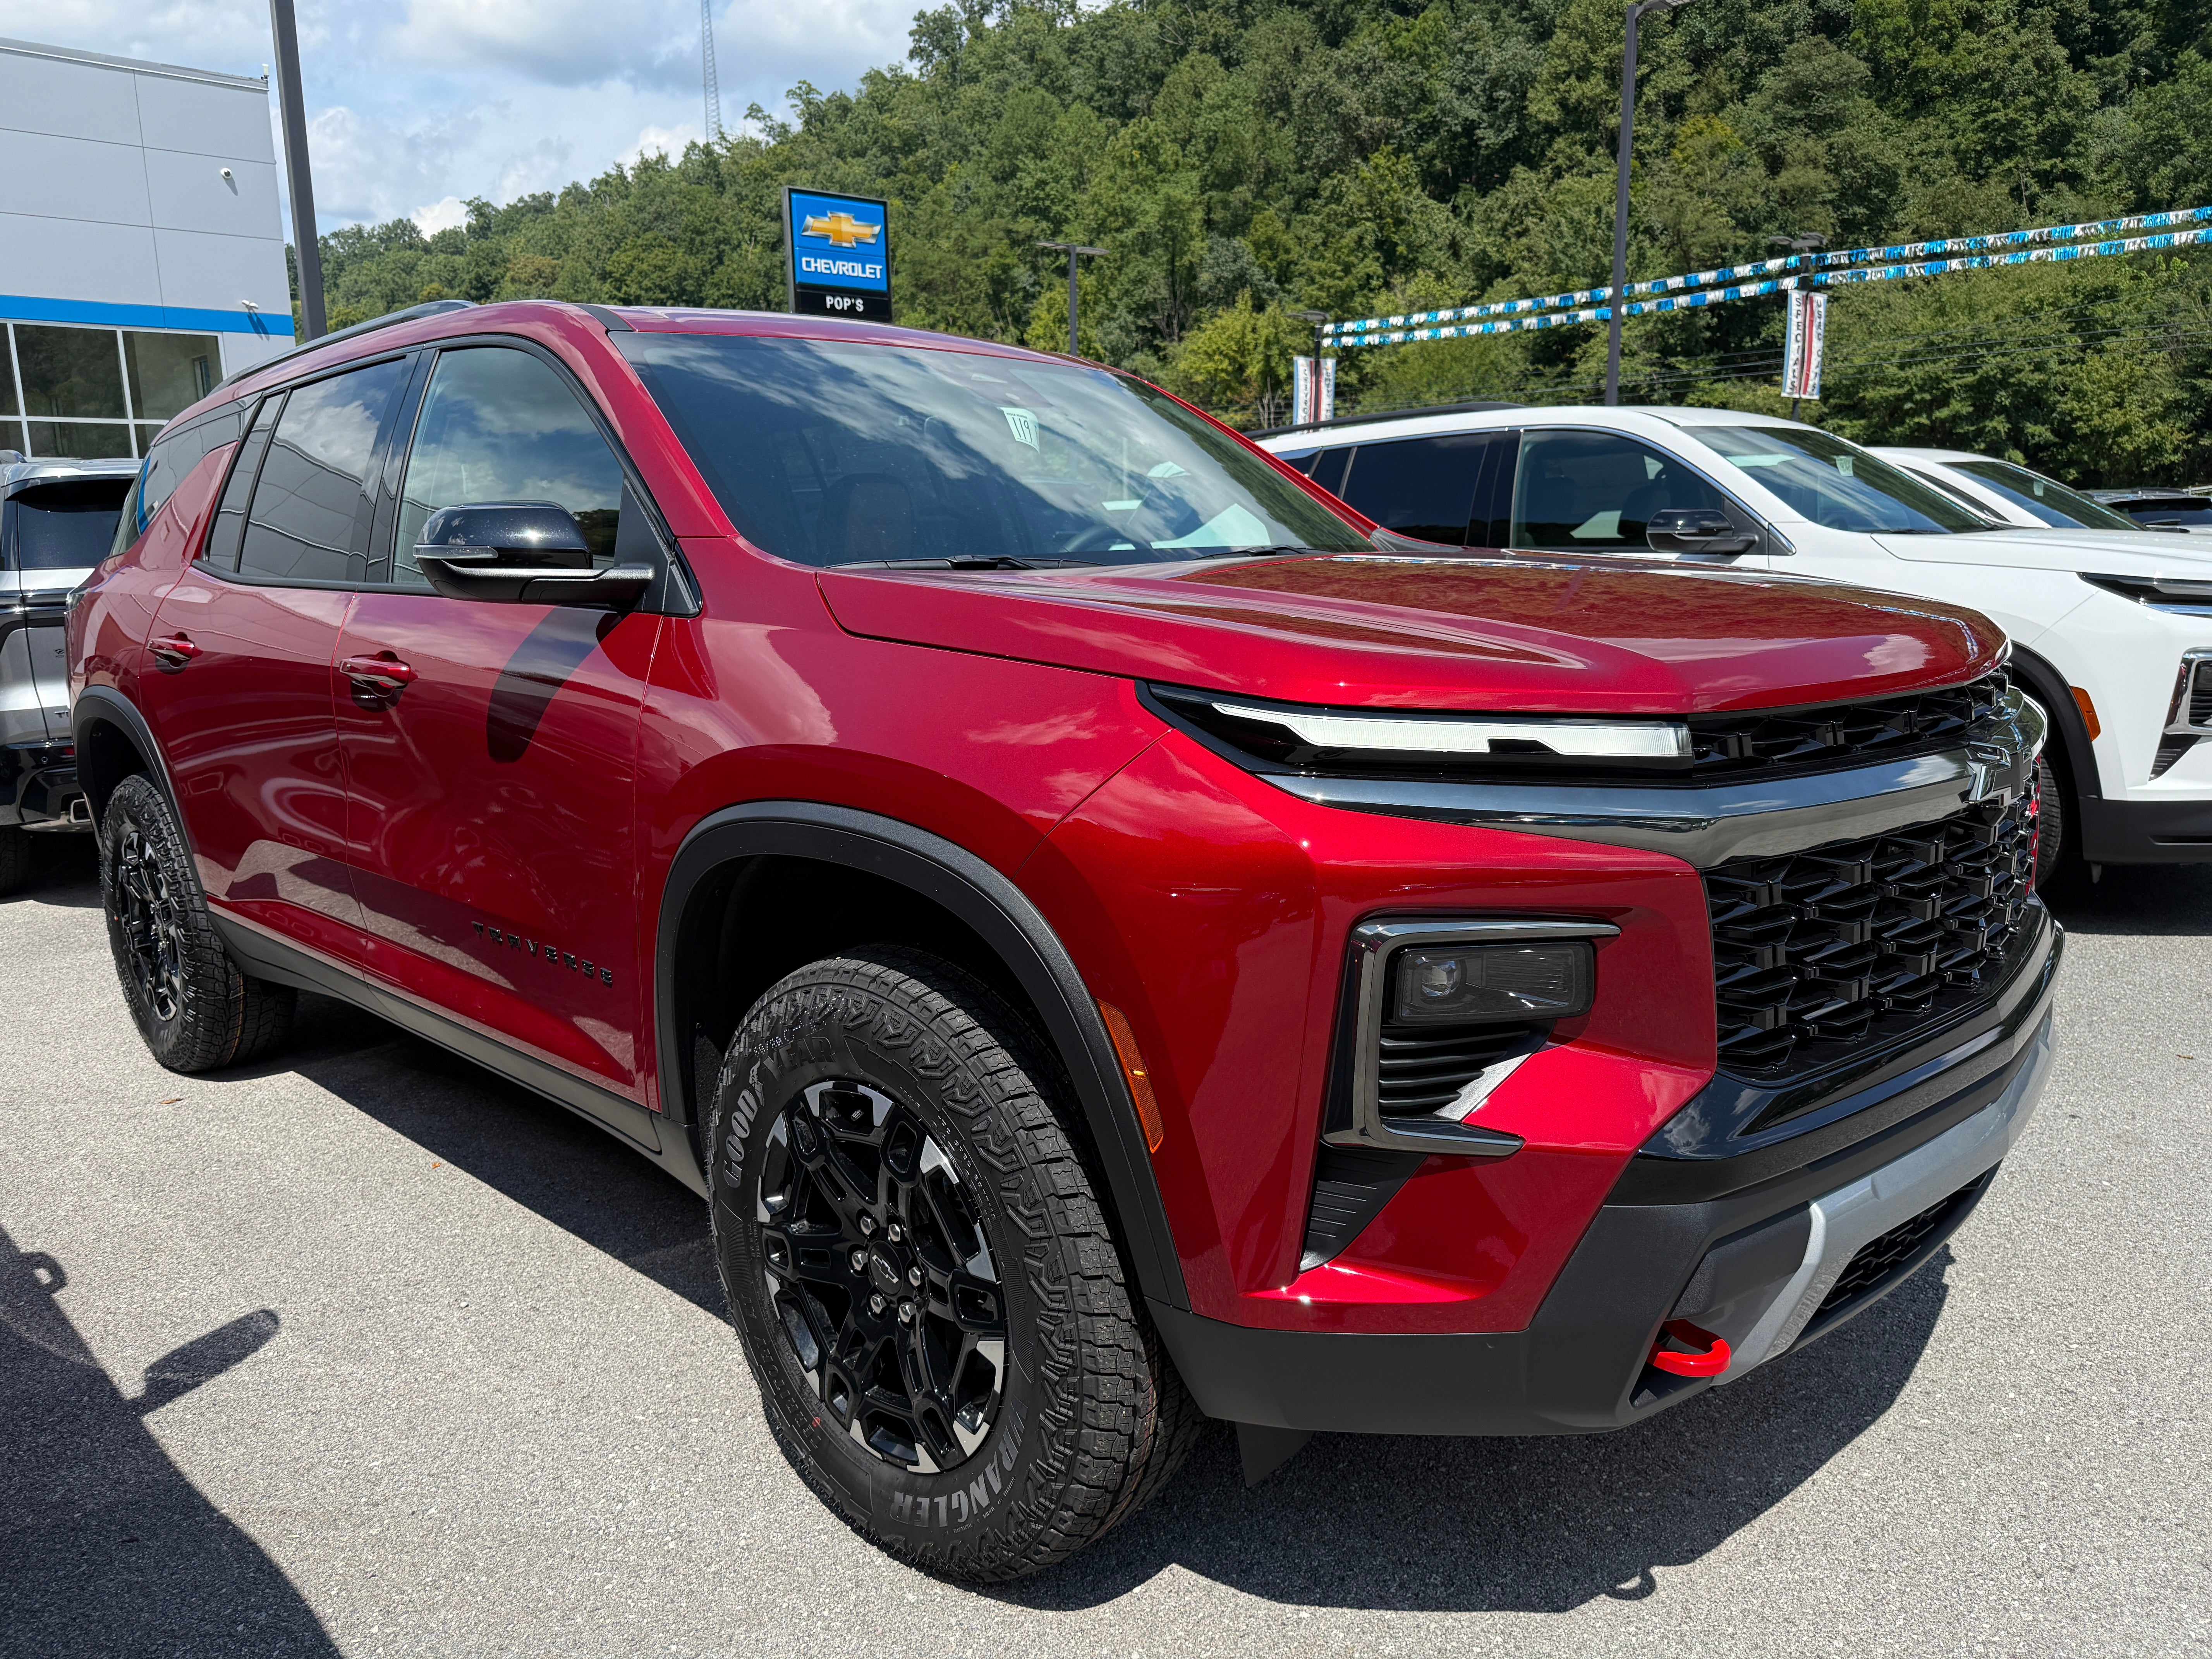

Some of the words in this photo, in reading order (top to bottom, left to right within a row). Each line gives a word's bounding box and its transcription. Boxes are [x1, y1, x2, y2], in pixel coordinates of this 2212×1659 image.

[801, 257, 883, 279] CHEVROLET
[826, 295, 864, 312] POP'S
[1790, 297, 1802, 392] SPECIALS
[471, 921, 613, 984] TRAVERSE
[723, 1037, 836, 1188] GOODYEAR
[890, 1398, 1028, 1528] WRANGLER
